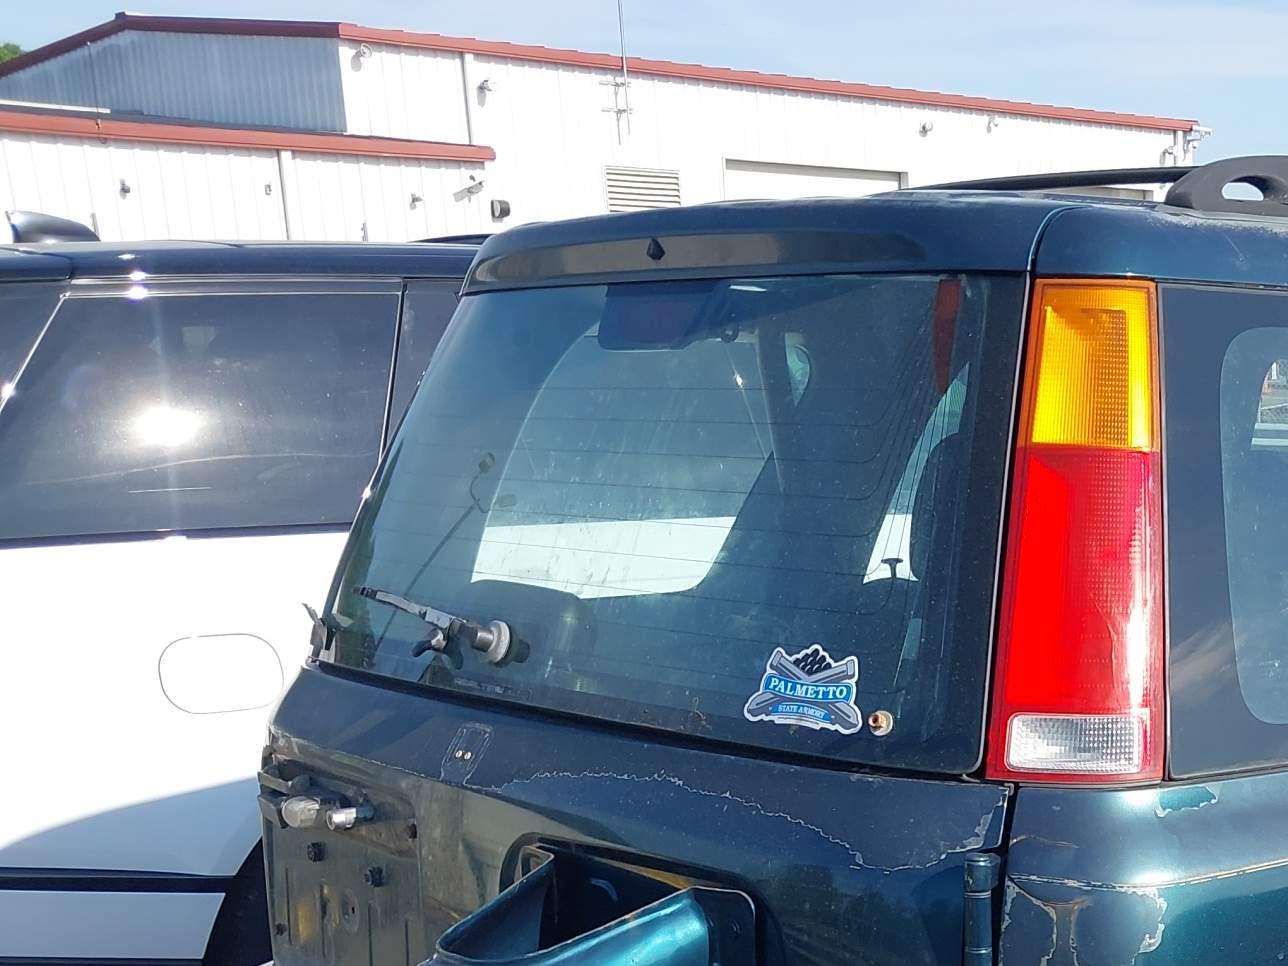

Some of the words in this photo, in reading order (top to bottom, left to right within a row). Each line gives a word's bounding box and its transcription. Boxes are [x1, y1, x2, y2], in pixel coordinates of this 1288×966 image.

[769, 678, 846, 699] PALMETTO
[778, 704, 797, 712] STATE
[798, 706, 825, 719] ARMORY
